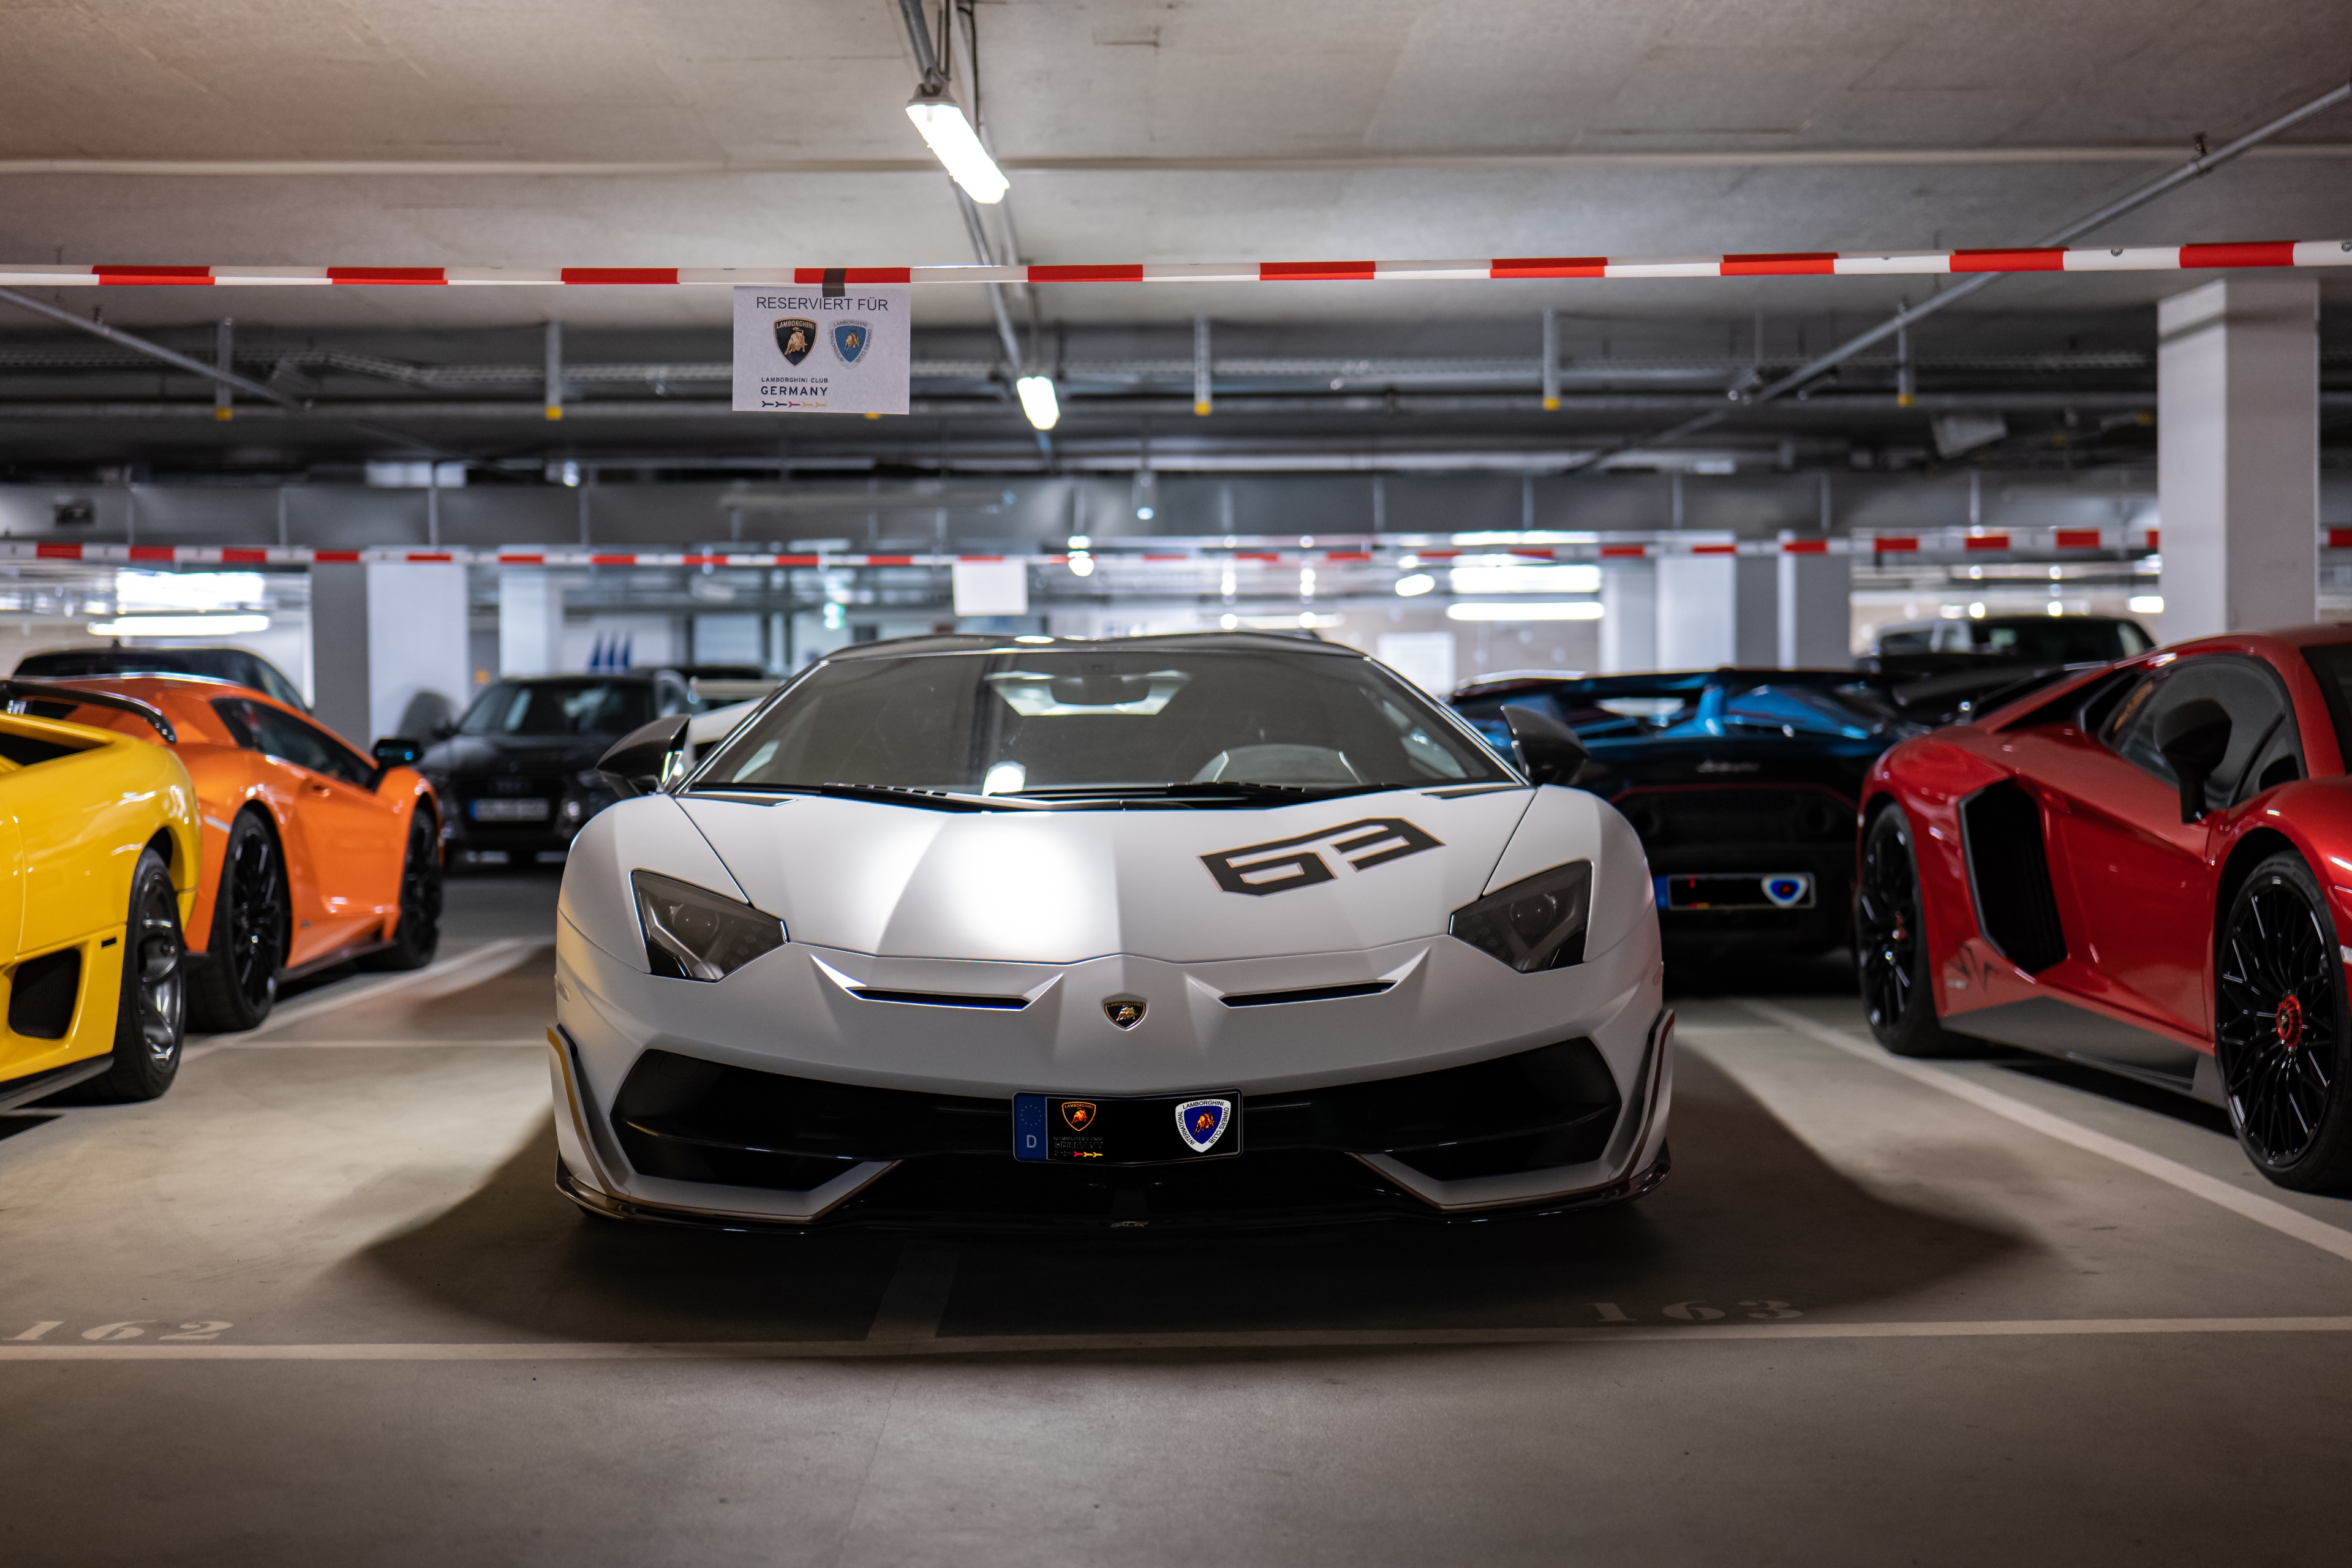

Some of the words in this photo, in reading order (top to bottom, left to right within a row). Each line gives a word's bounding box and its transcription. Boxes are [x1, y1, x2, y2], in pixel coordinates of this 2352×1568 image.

[756, 296, 853, 311] RESERVIERT
[858, 296, 889, 311] FÜR
[776, 320, 815, 330] LAMBORGHINI
[829, 328, 845, 363] INTERNATIONAL
[864, 329, 872, 352] OWNERS
[855, 351, 867, 363] CLUB
[760, 386, 828, 396] GERMANY
[1196, 816, 1447, 899] 63
[1182, 1100, 1224, 1109] LAMBORGHINI
[1177, 1110, 1196, 1145] INTERNATIONAL
[1218, 1107, 1229, 1130] OWNERS
[1026, 1134, 1037, 1148] D
[1208, 1130, 1222, 1144] CLUB
[1585, 1300, 1804, 1322] 163
[1, 1319, 234, 1341] 162
